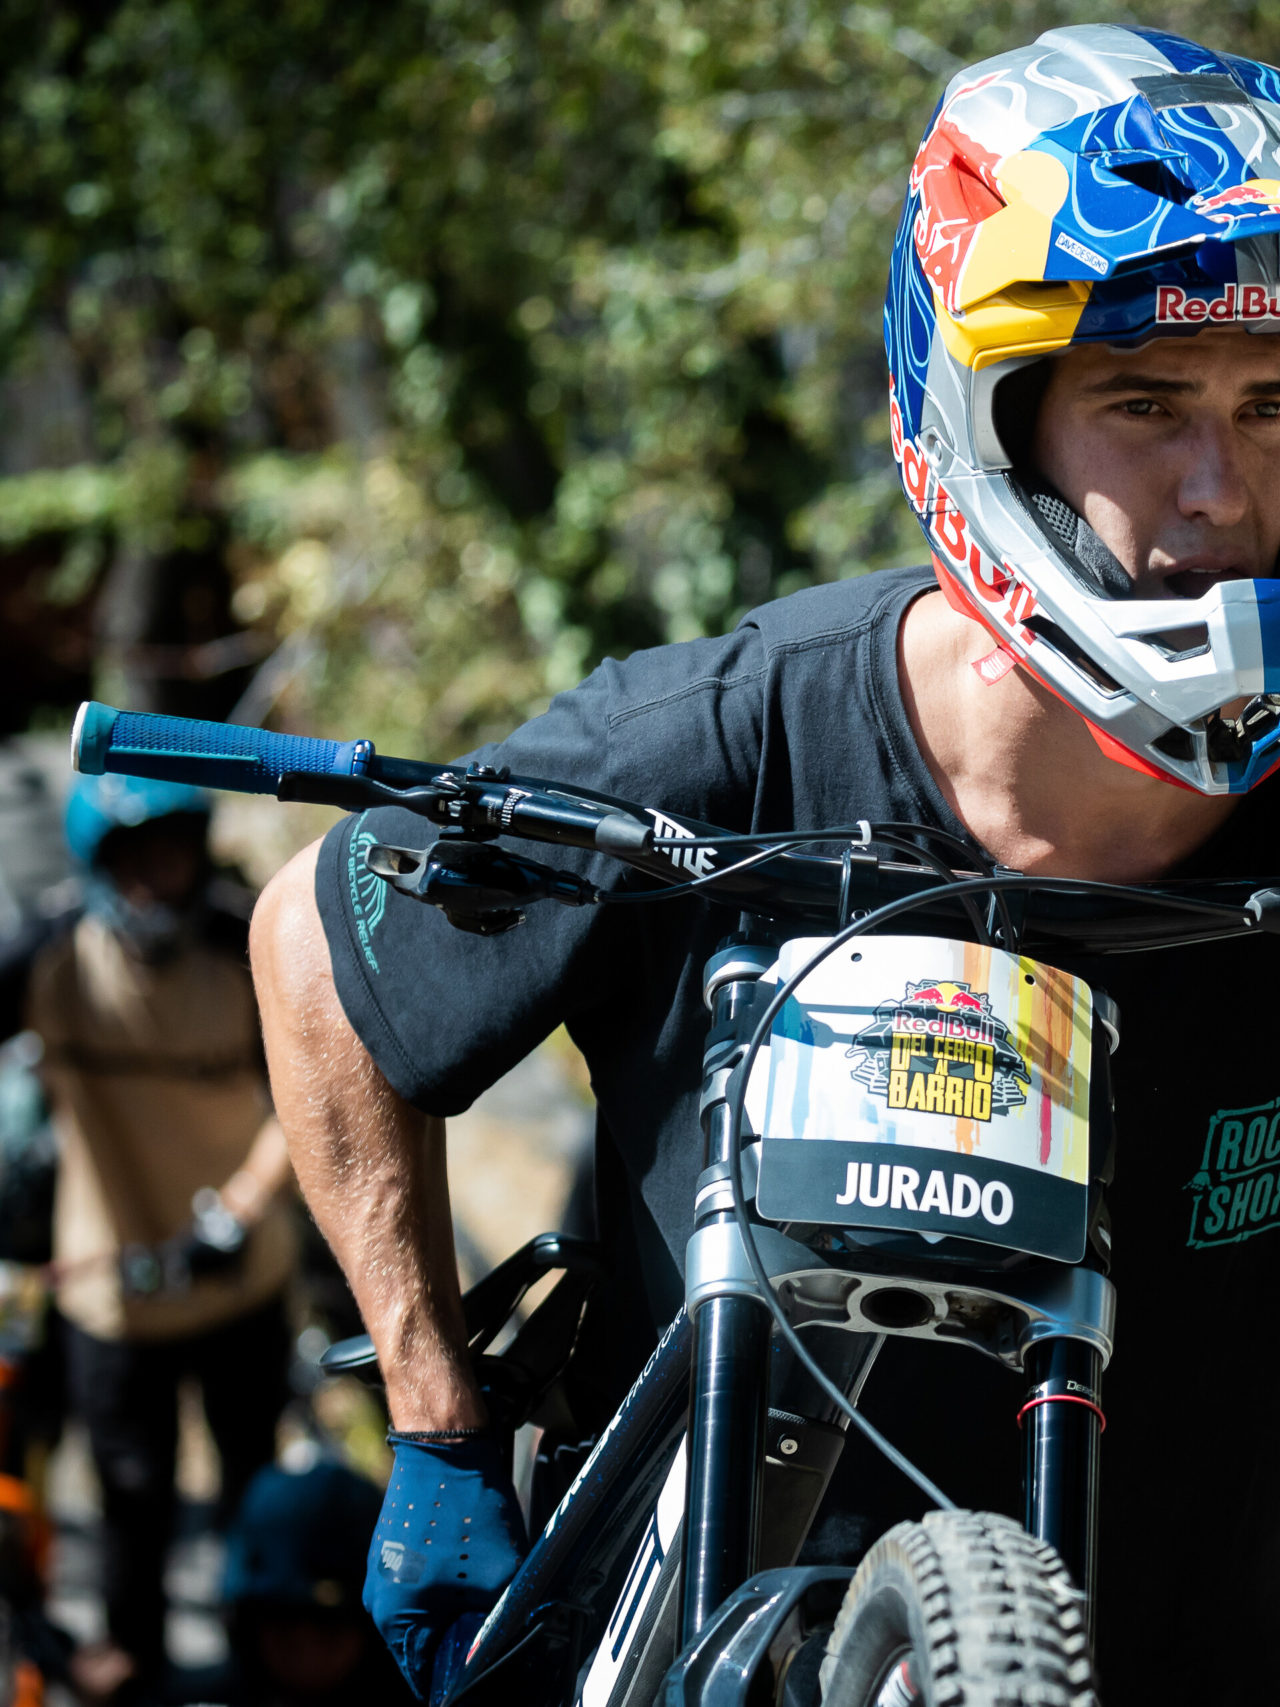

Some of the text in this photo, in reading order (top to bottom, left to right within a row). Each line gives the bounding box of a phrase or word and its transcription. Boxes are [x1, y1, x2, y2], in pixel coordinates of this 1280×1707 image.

[1156, 283, 1237, 322] Red
[347, 857, 364, 916] BICYCLE
[355, 919, 378, 974] RELIEF
[895, 1010, 994, 1043] Red Bull
[891, 1032, 995, 1083] DEL CERRO
[935, 1058, 949, 1077] AL
[888, 1070, 993, 1121] BARRIO
[835, 1161, 1015, 1226] JURADO
